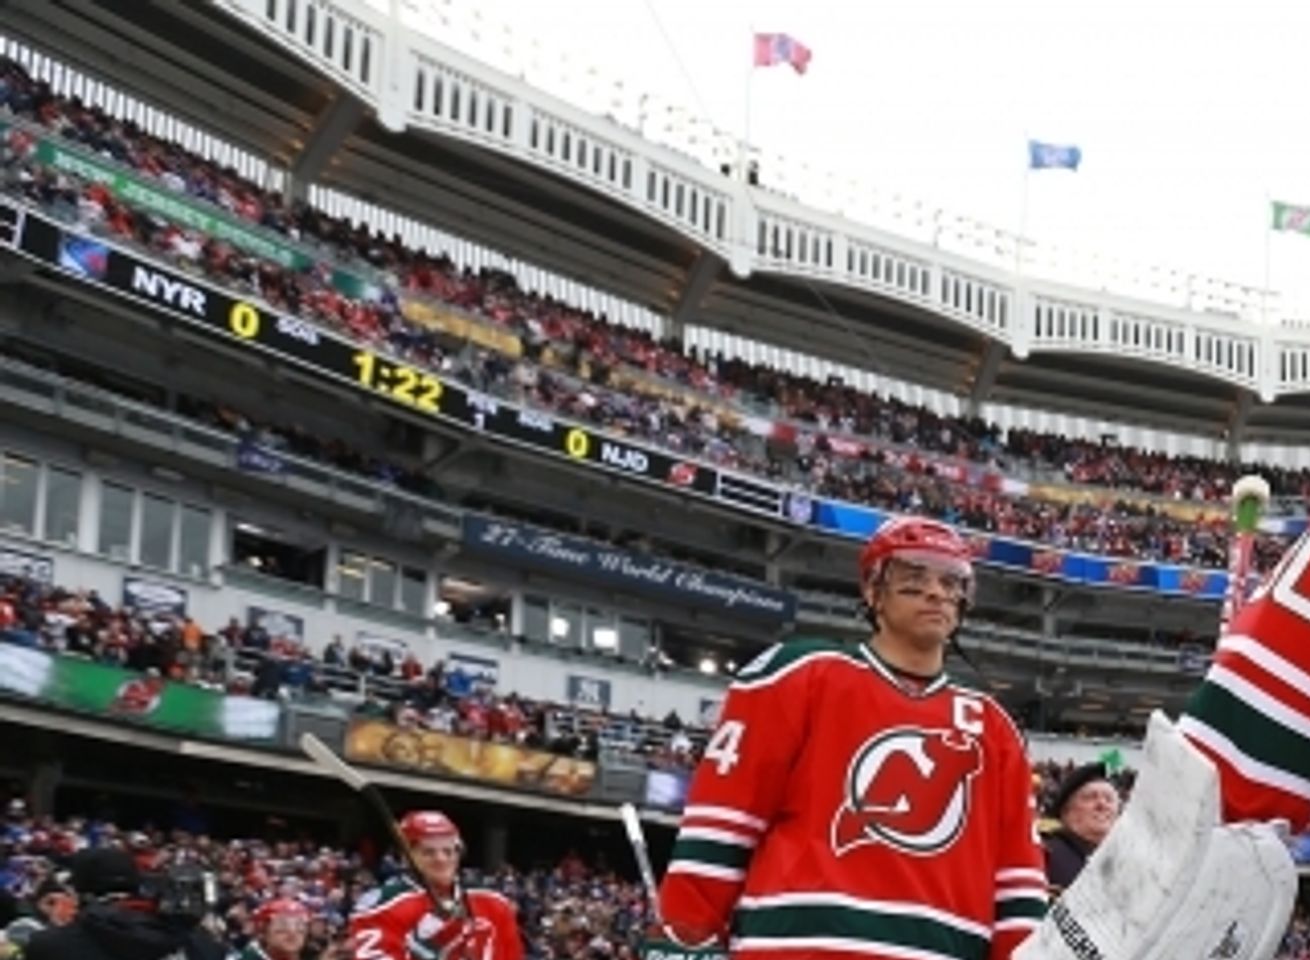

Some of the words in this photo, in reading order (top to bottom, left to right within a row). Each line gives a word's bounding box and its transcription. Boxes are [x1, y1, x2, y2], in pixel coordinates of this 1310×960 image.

[132, 266, 206, 317] NYR
[229, 302, 260, 338] 0
[353, 352, 443, 413] 1:22
[566, 429, 589, 460] 0
[597, 550, 674, 585] World
[952, 695, 985, 735] C
